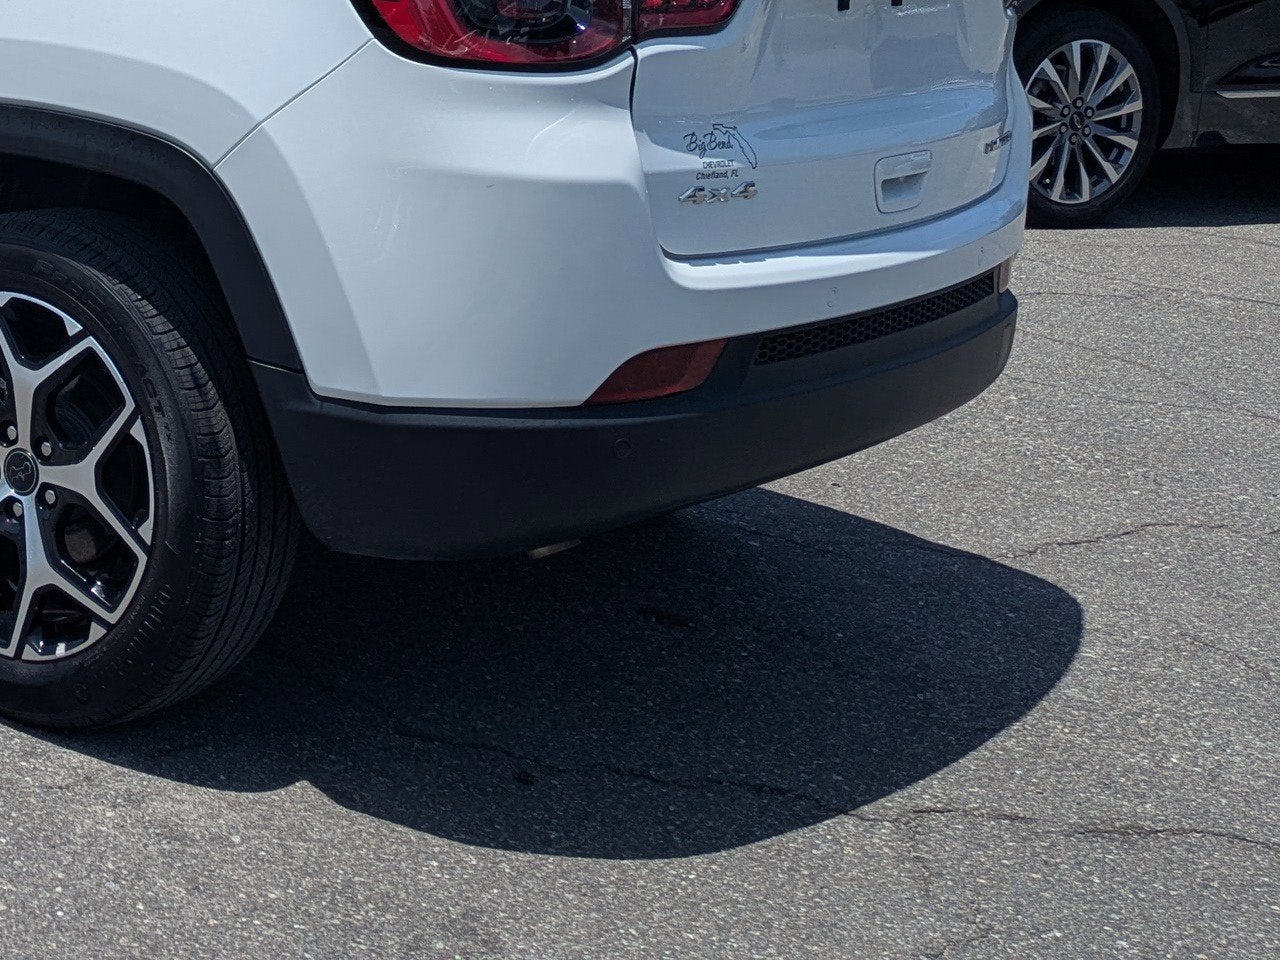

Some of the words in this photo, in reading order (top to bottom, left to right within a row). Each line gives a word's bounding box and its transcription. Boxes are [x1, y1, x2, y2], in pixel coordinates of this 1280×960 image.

[683, 131, 707, 159] Big
[703, 131, 734, 151] Bend
[702, 159, 735, 170] CHEVROLET
[731, 168, 739, 178] FL
